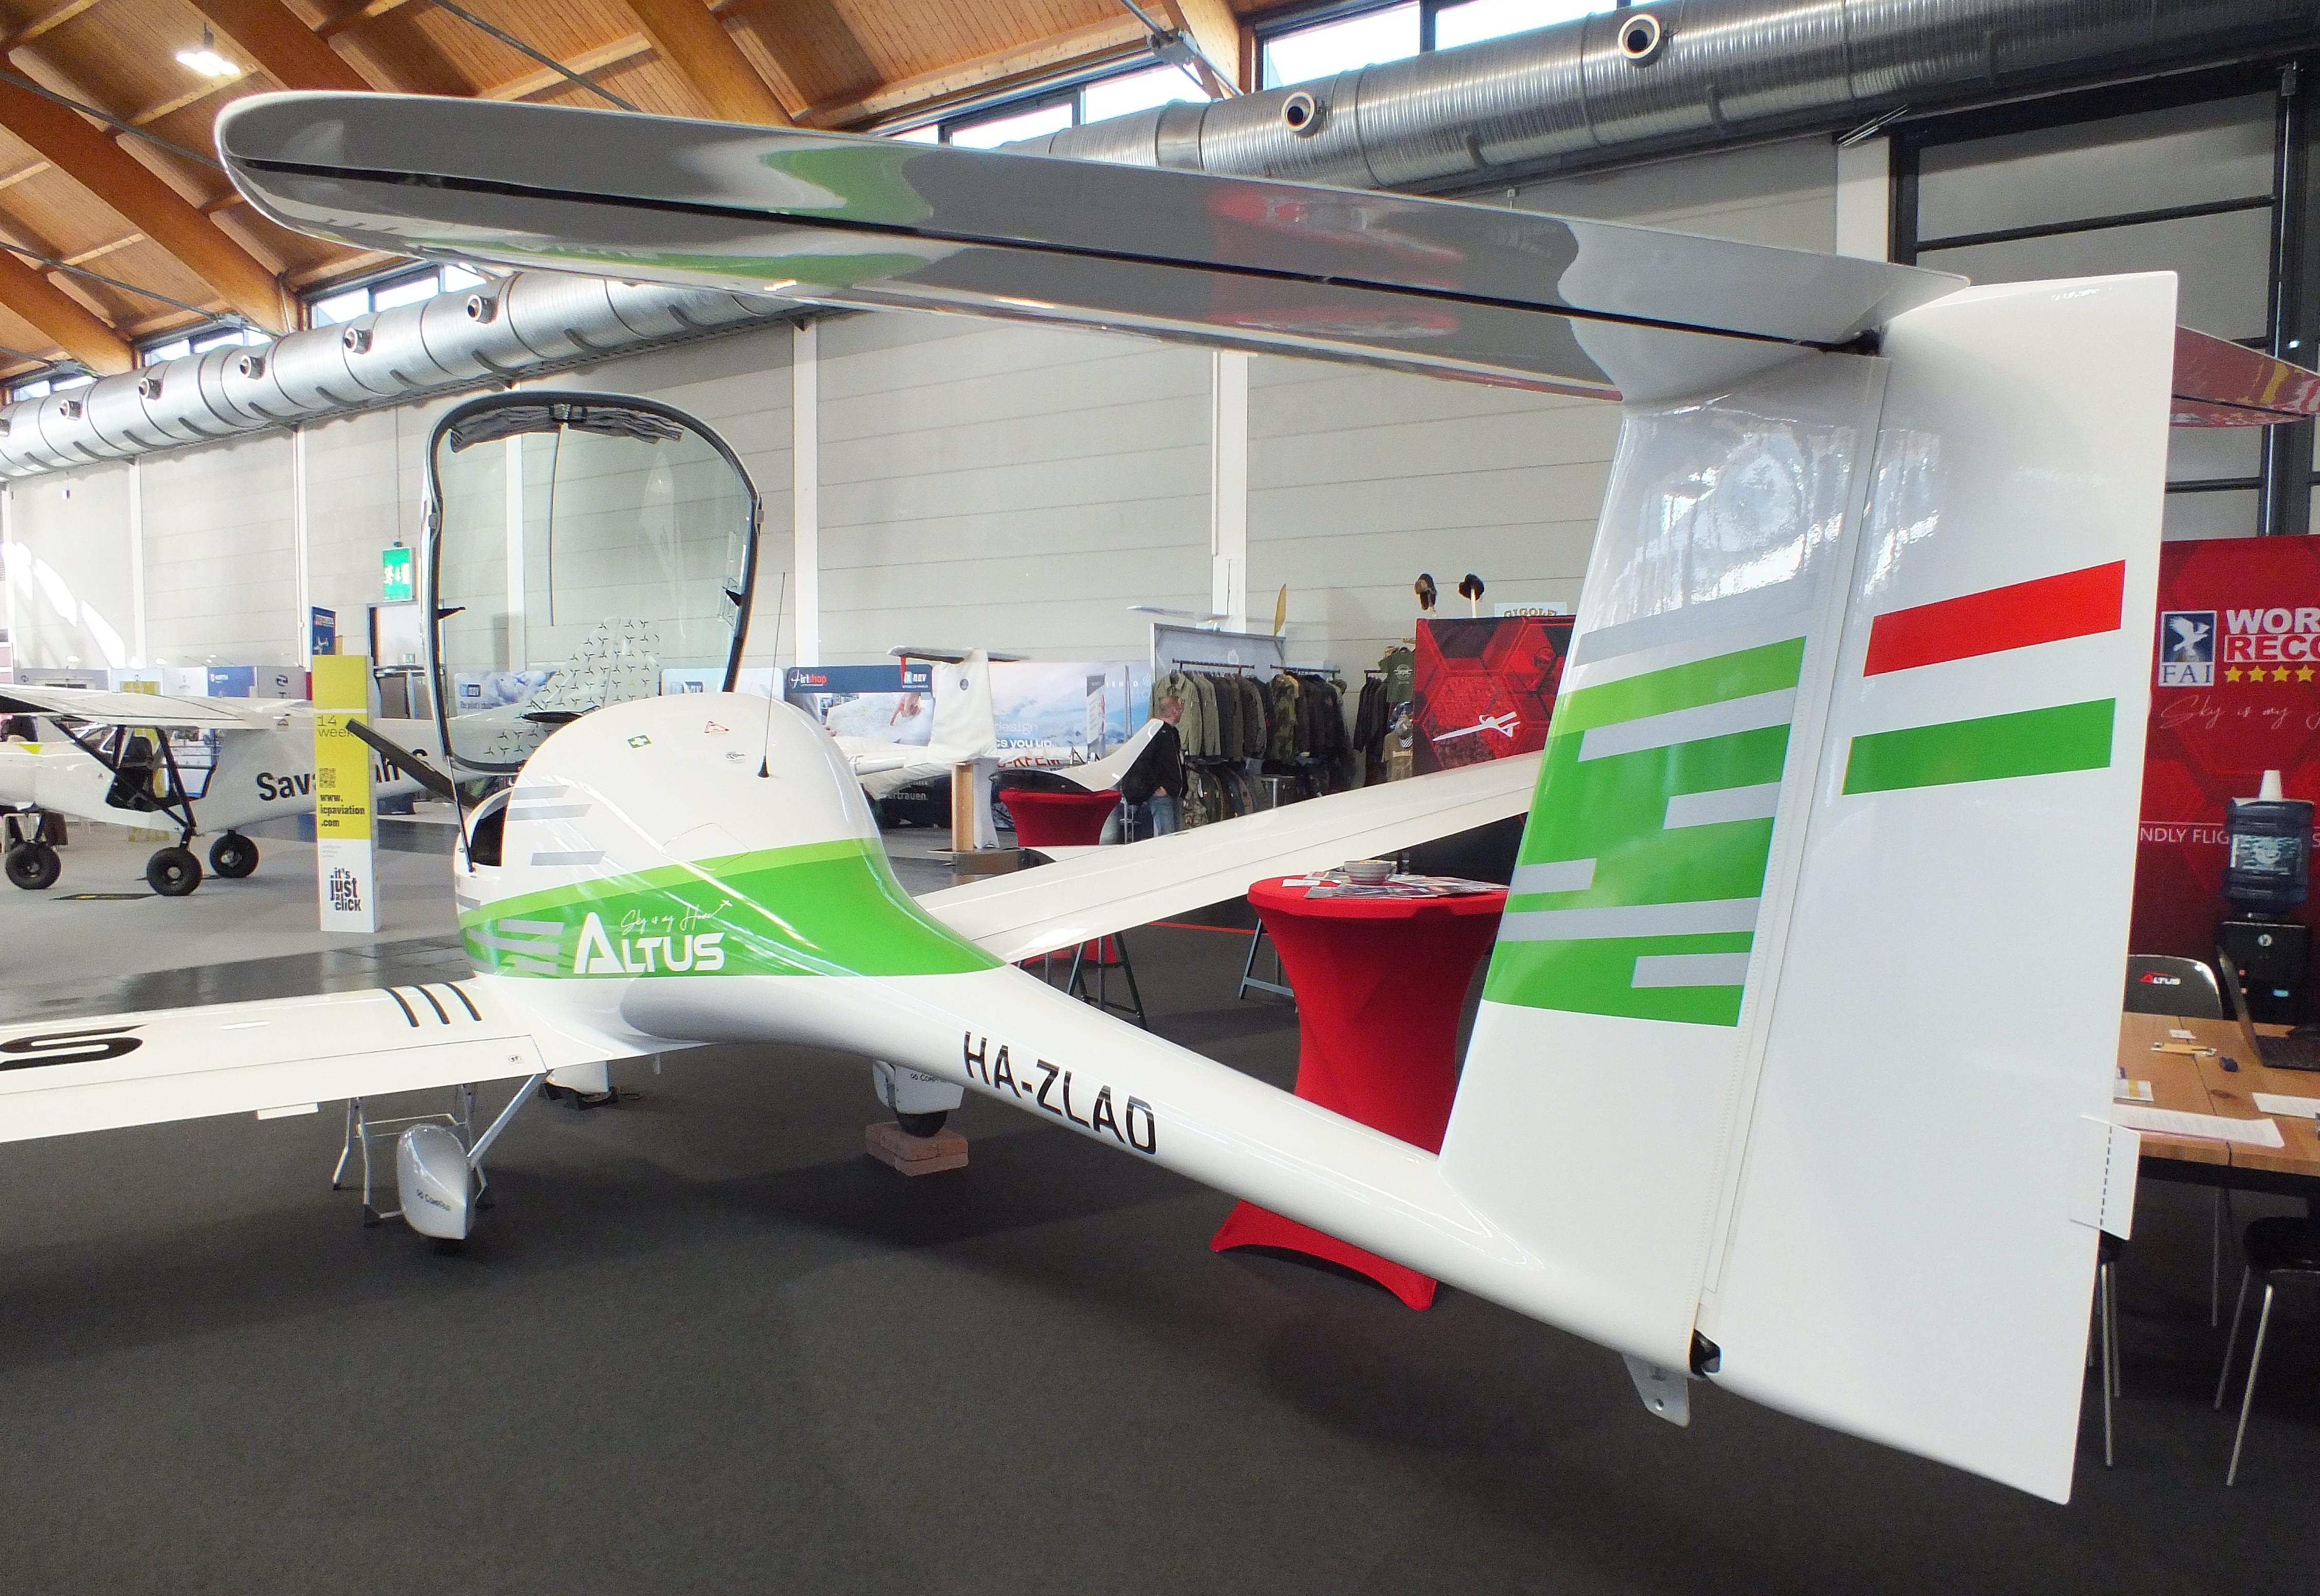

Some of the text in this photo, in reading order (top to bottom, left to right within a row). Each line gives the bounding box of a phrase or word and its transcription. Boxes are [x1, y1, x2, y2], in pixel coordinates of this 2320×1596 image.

[2226, 608, 2320, 634] WOR
[2162, 664, 2214, 683] FAI
[317, 715, 337, 727] 14
[1010, 739, 1033, 749] you
[887, 791, 929, 801] ertrauen.
[320, 805, 365, 817] icpaviation
[321, 819, 340, 827] .com
[963, 1030, 1157, 1155] HA-ZLAD
